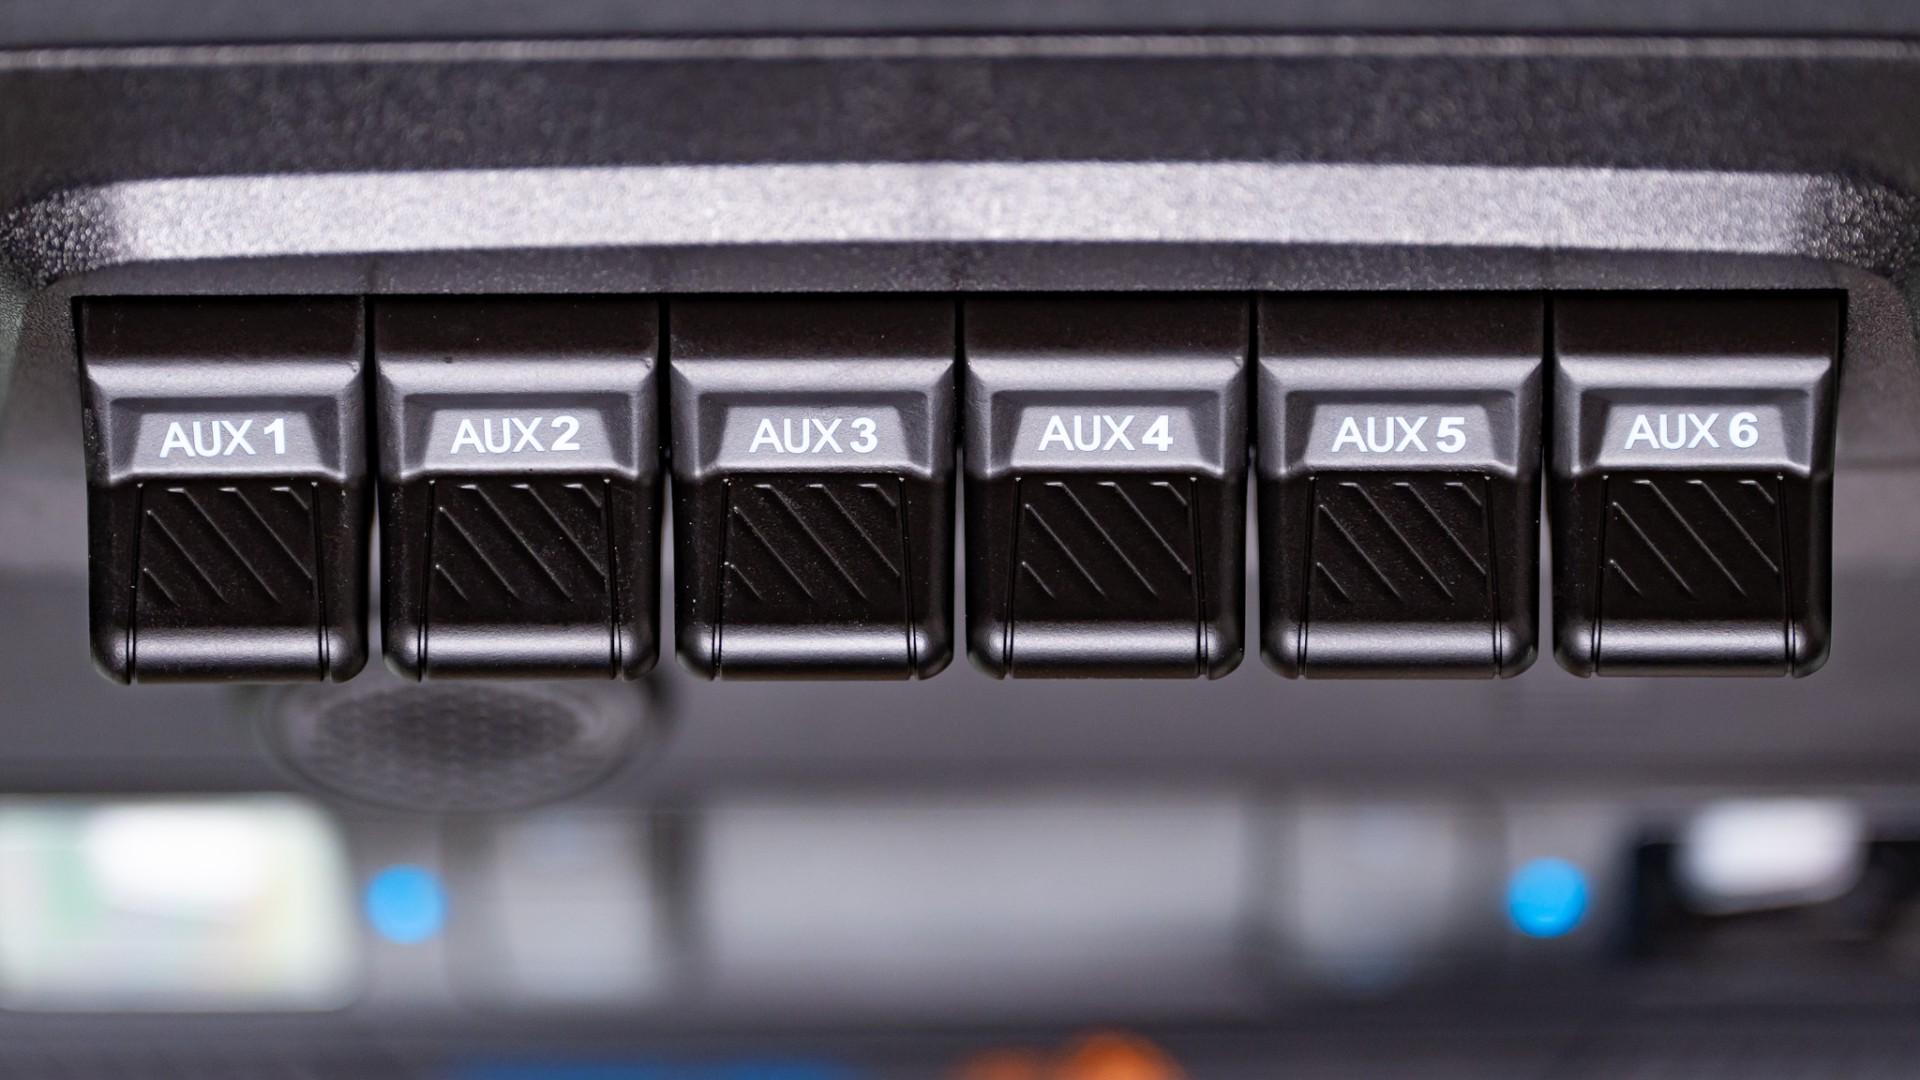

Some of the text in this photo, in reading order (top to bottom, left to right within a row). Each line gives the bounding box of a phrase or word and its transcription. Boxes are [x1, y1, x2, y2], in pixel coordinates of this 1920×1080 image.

[159, 417, 287, 458] AUX 1
[449, 415, 581, 455] AUX 2
[748, 416, 879, 455] AUX 3
[1036, 414, 1174, 452] AUX 4
[1331, 415, 1467, 454] AUX 5
[1623, 411, 1759, 450] AUX 6
